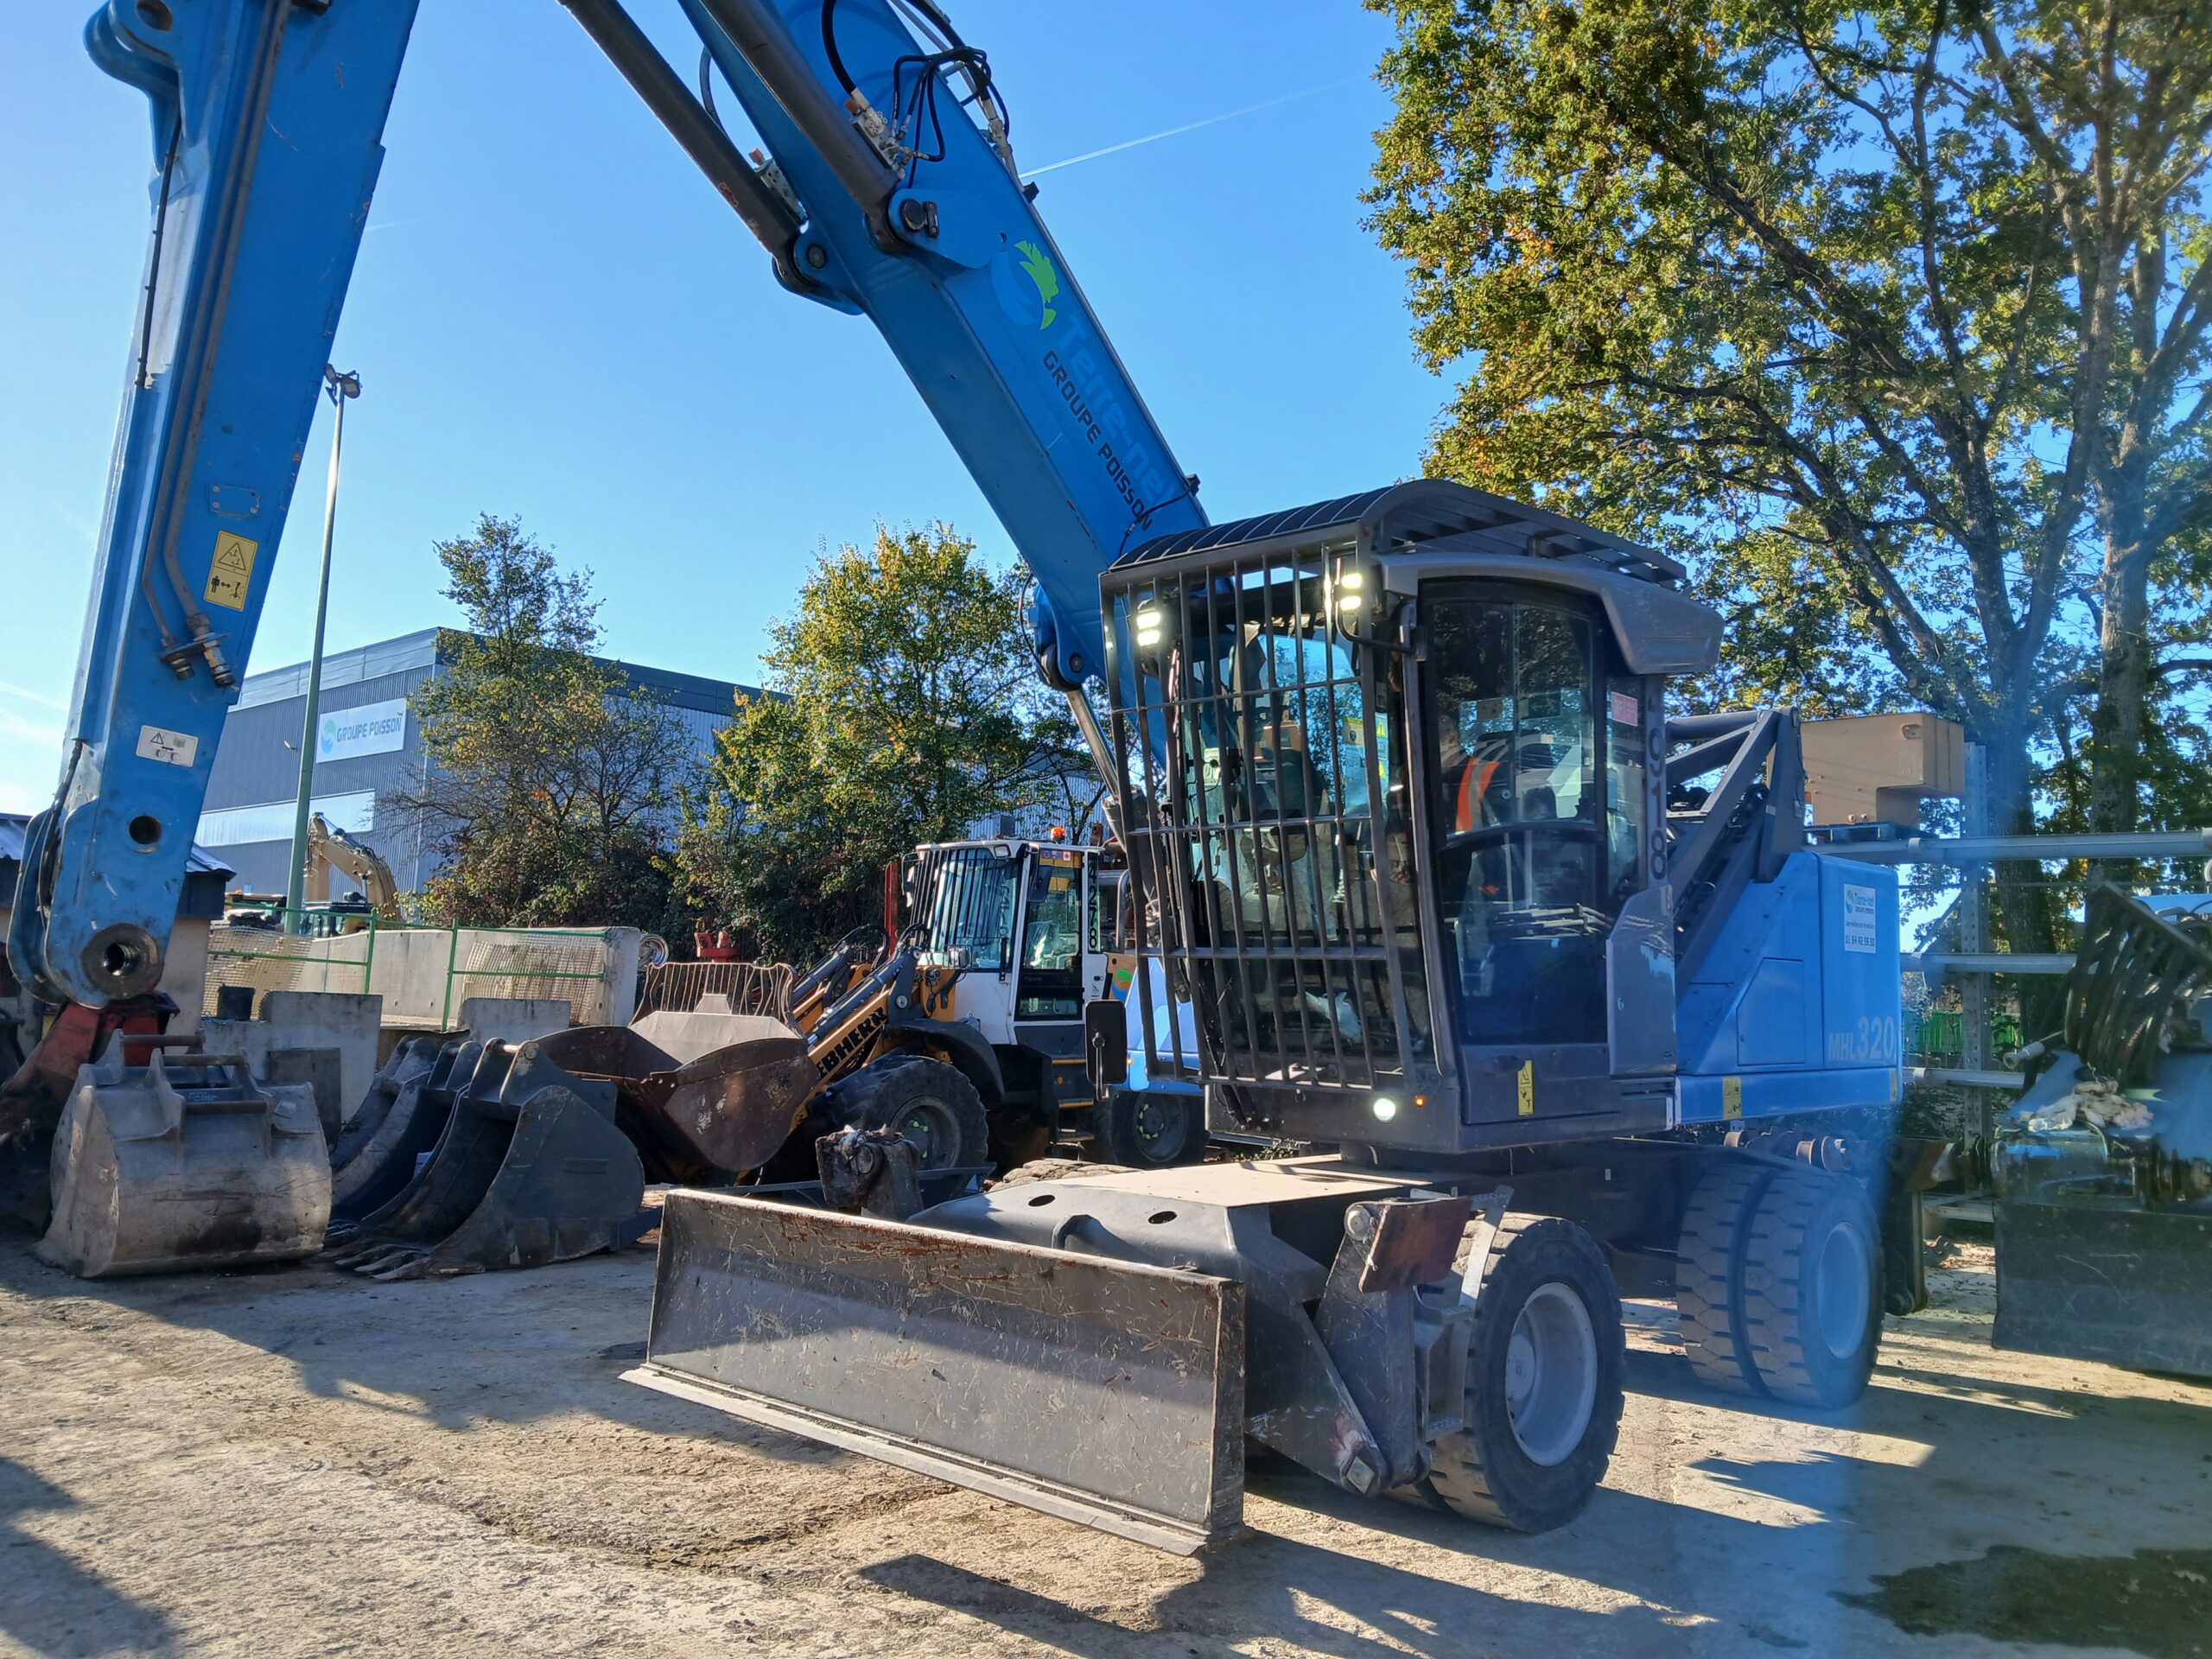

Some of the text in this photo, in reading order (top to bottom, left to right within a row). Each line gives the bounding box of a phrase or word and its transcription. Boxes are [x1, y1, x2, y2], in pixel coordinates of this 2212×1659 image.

[1043, 350, 1154, 531] GROUPE POISSON
[336, 717, 402, 742] GROUPE POISSON
[1648, 697, 1668, 880] 918
[1088, 865, 1097, 949] 4278
